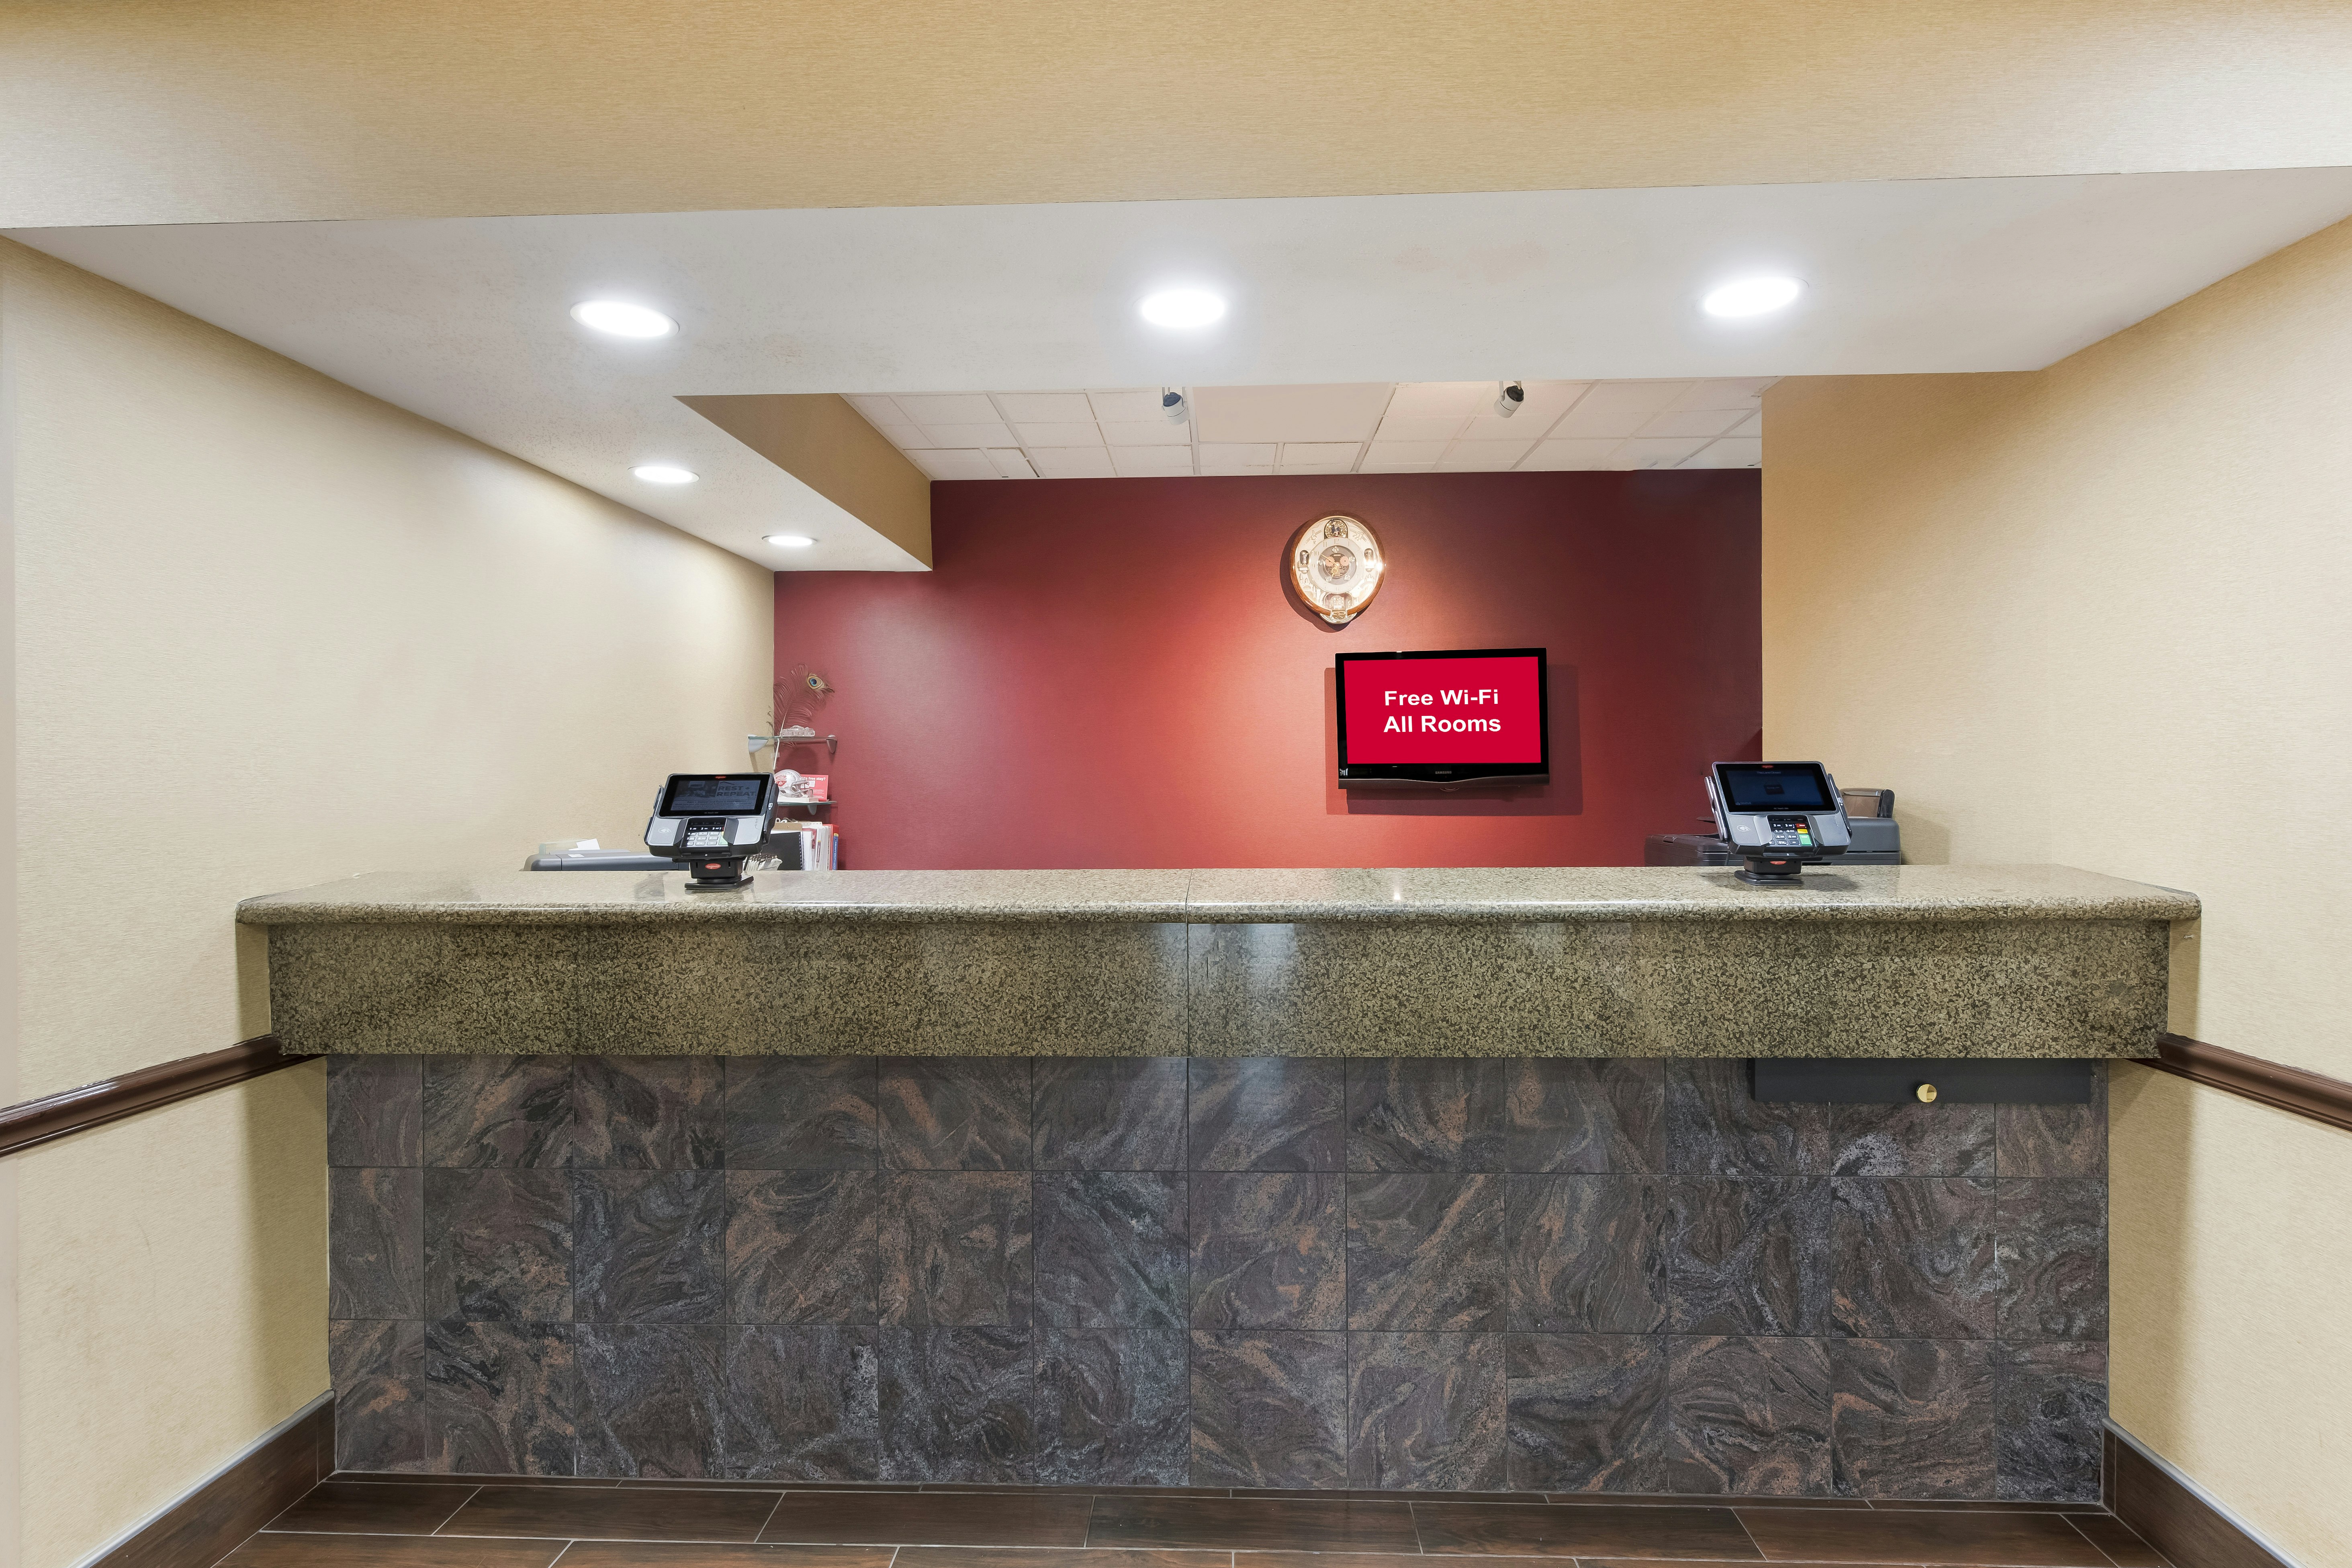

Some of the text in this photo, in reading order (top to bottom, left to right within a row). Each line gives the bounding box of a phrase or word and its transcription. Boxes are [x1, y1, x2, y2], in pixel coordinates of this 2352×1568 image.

[1385, 689, 1498, 705] Free Wi-Fi
[1383, 716, 1501, 732] All Rooms
